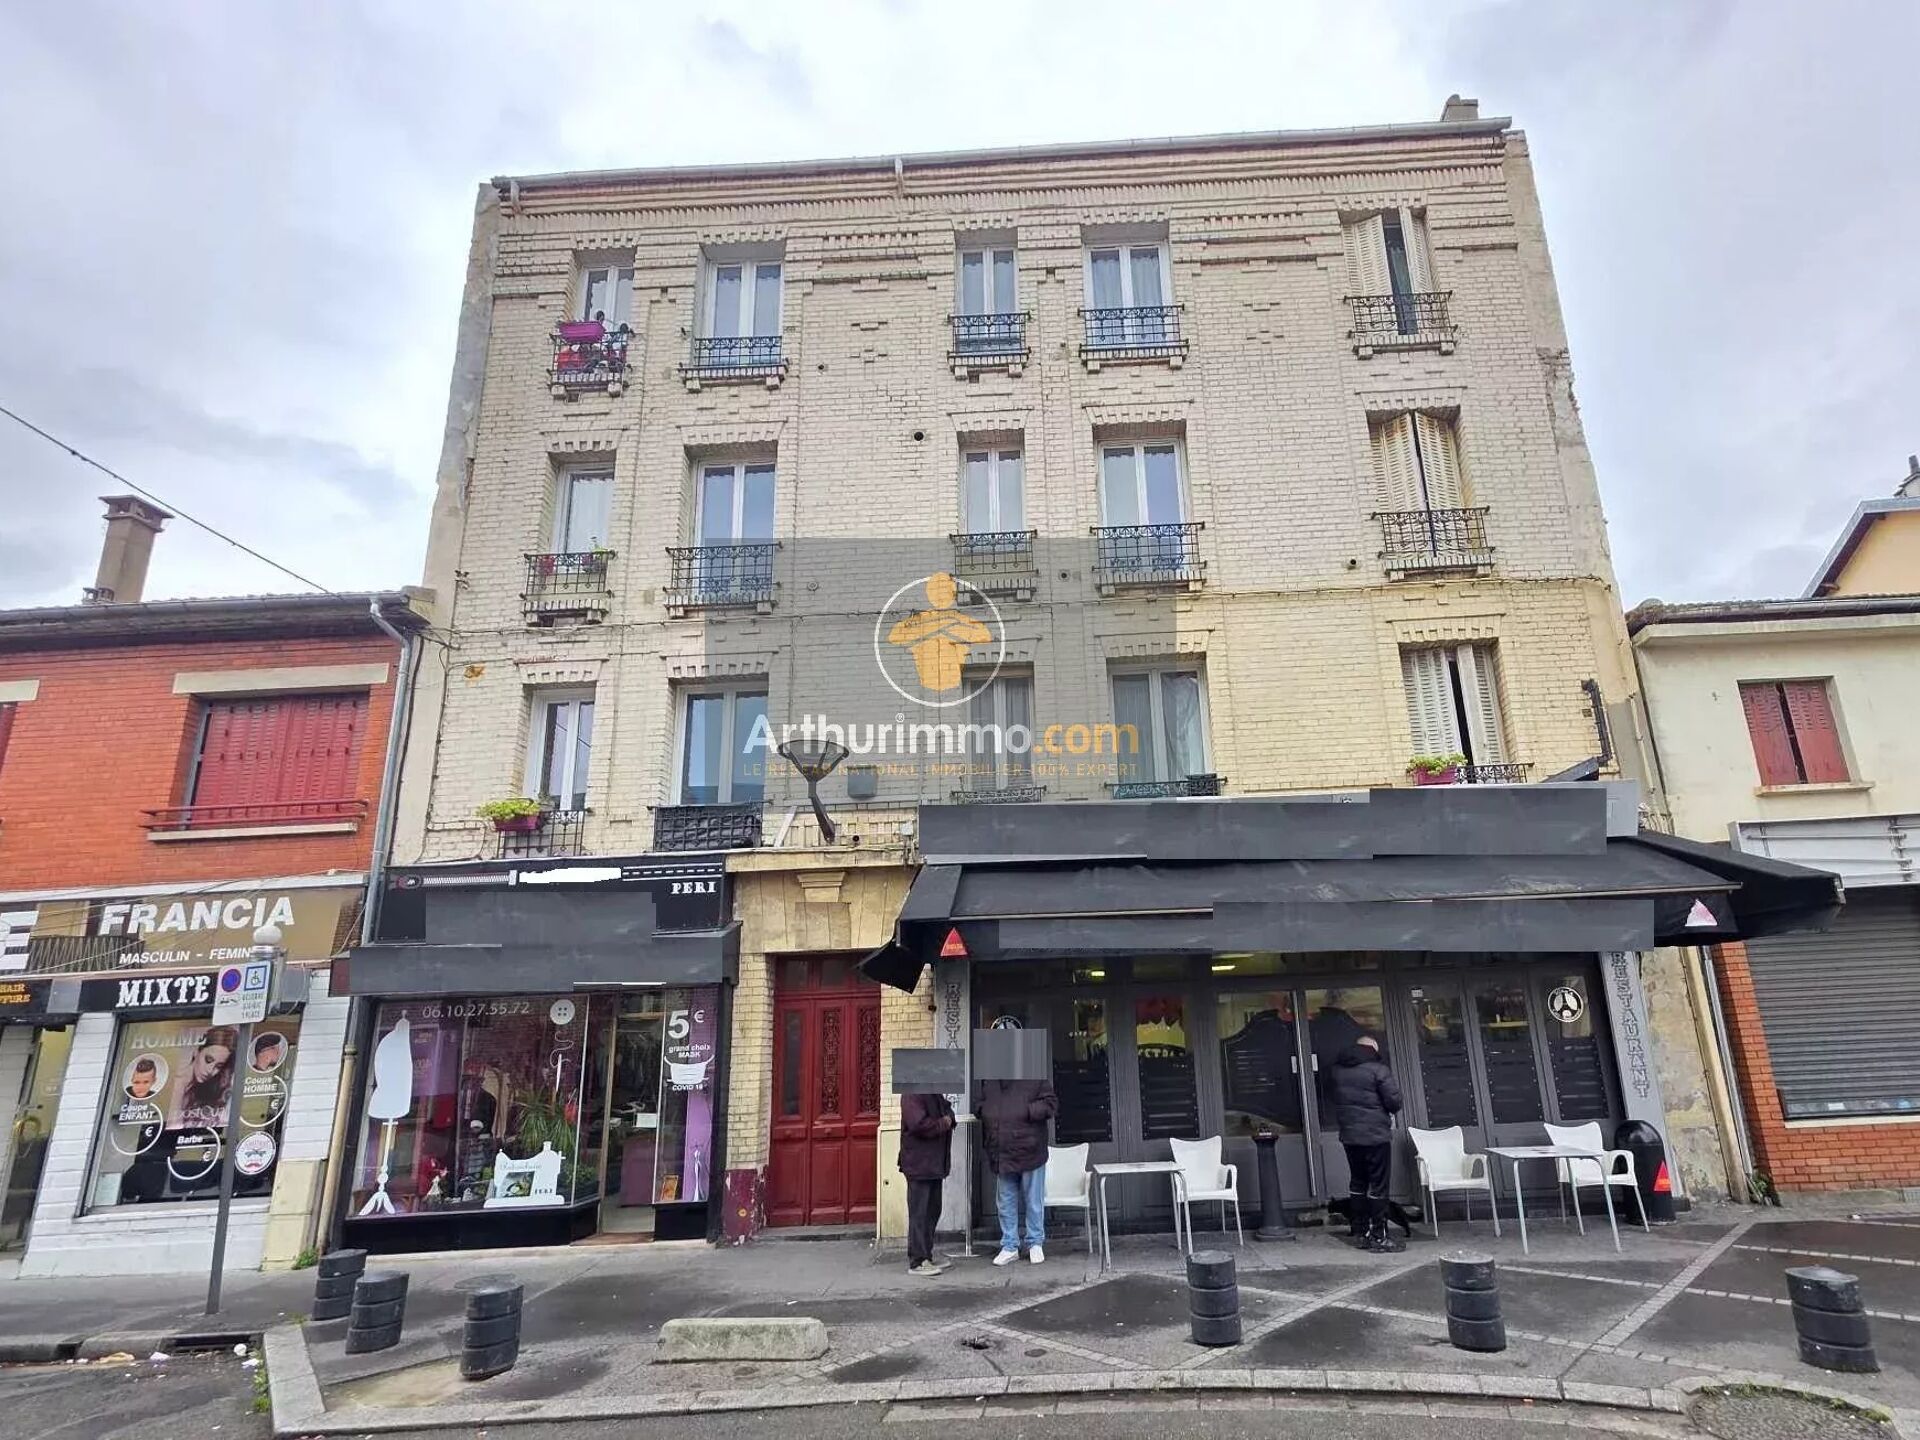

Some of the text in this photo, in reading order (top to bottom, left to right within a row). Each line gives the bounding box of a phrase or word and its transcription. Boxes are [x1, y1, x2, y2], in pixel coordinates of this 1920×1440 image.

[671, 881, 716, 894] PERI
[99, 897, 295, 936] FRANCIA
[120, 951, 190, 965] MASCULIN
[209, 947, 251, 960] FEMIN
[115, 976, 210, 1008] MIXTE
[422, 1002, 529, 1019] 06.10.27.55.72
[668, 1010, 705, 1039] 5 €
[1611, 952, 1650, 1098] RESTAURANT
[669, 1045, 689, 1054] grand
[243, 1084, 278, 1093] HOMME
[119, 1111, 155, 1121] ENFANT
[121, 1104, 148, 1113] Coupe
[177, 1136, 203, 1145] Barbe
